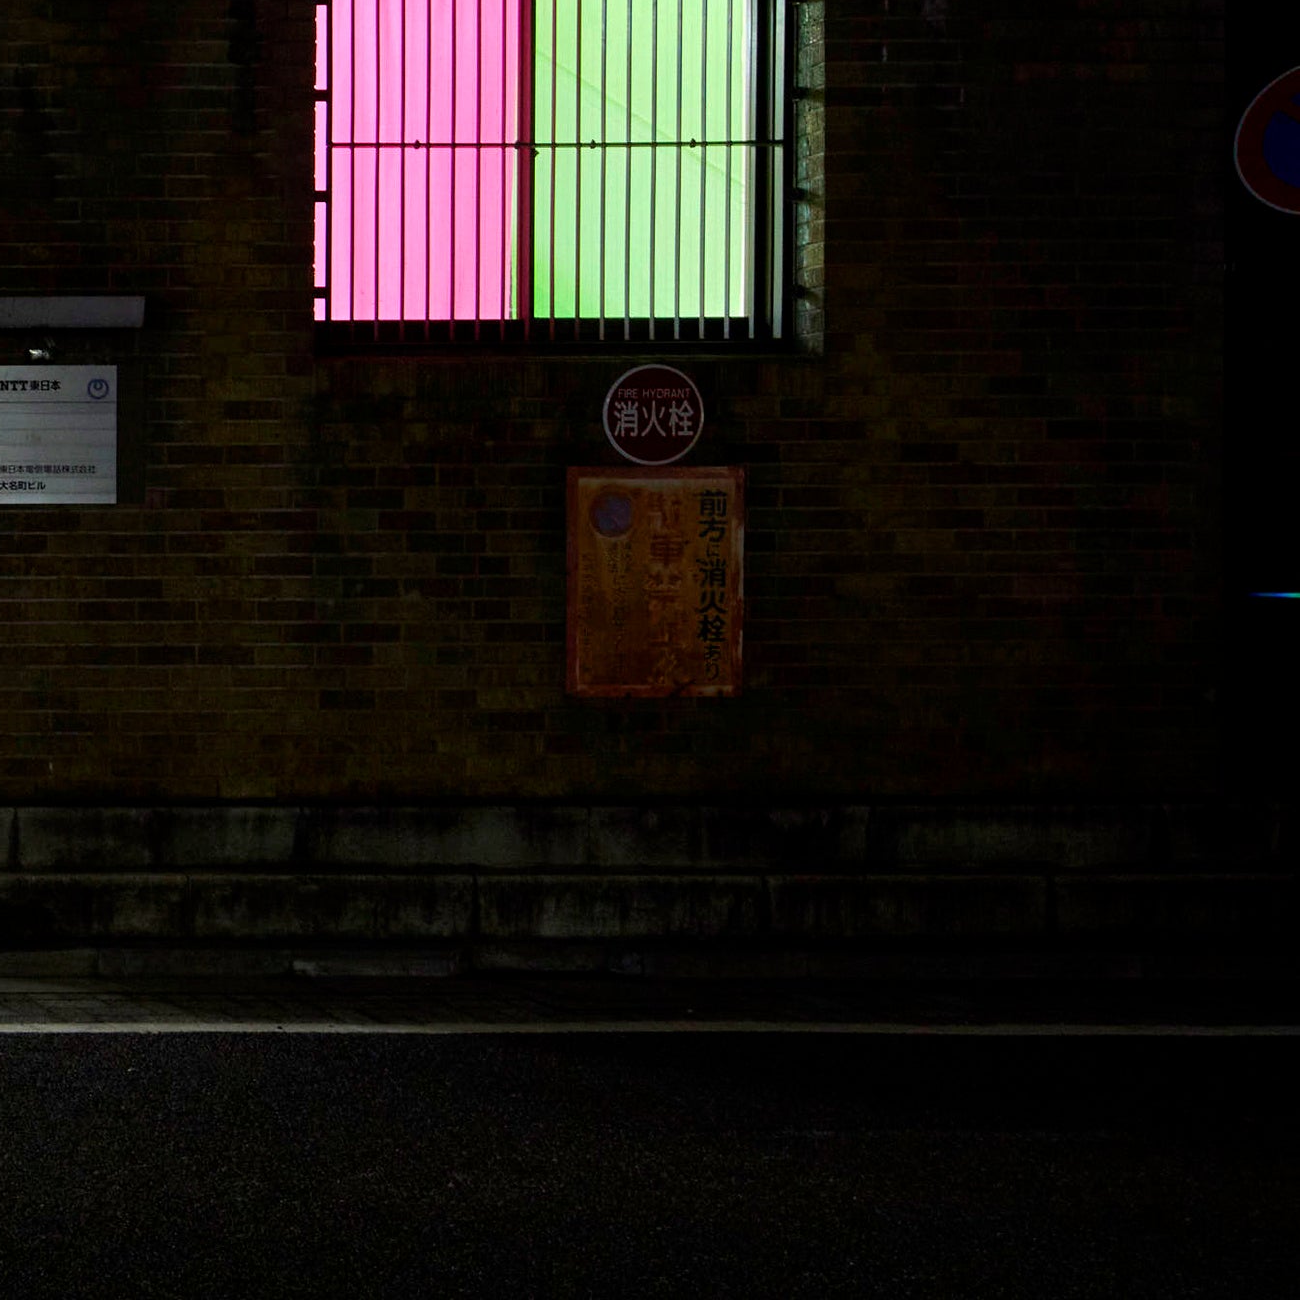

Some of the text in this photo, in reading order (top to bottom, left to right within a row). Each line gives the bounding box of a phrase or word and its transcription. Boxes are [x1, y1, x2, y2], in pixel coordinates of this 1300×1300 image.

[0, 380, 62, 392] NTT東日本
[617, 387, 691, 398] FIRE HYDRANT
[613, 400, 695, 438] 消火栓
[0, 464, 96, 474] 東日本電信電話株式会社
[696, 489, 727, 681] 前方に消火栓あり
